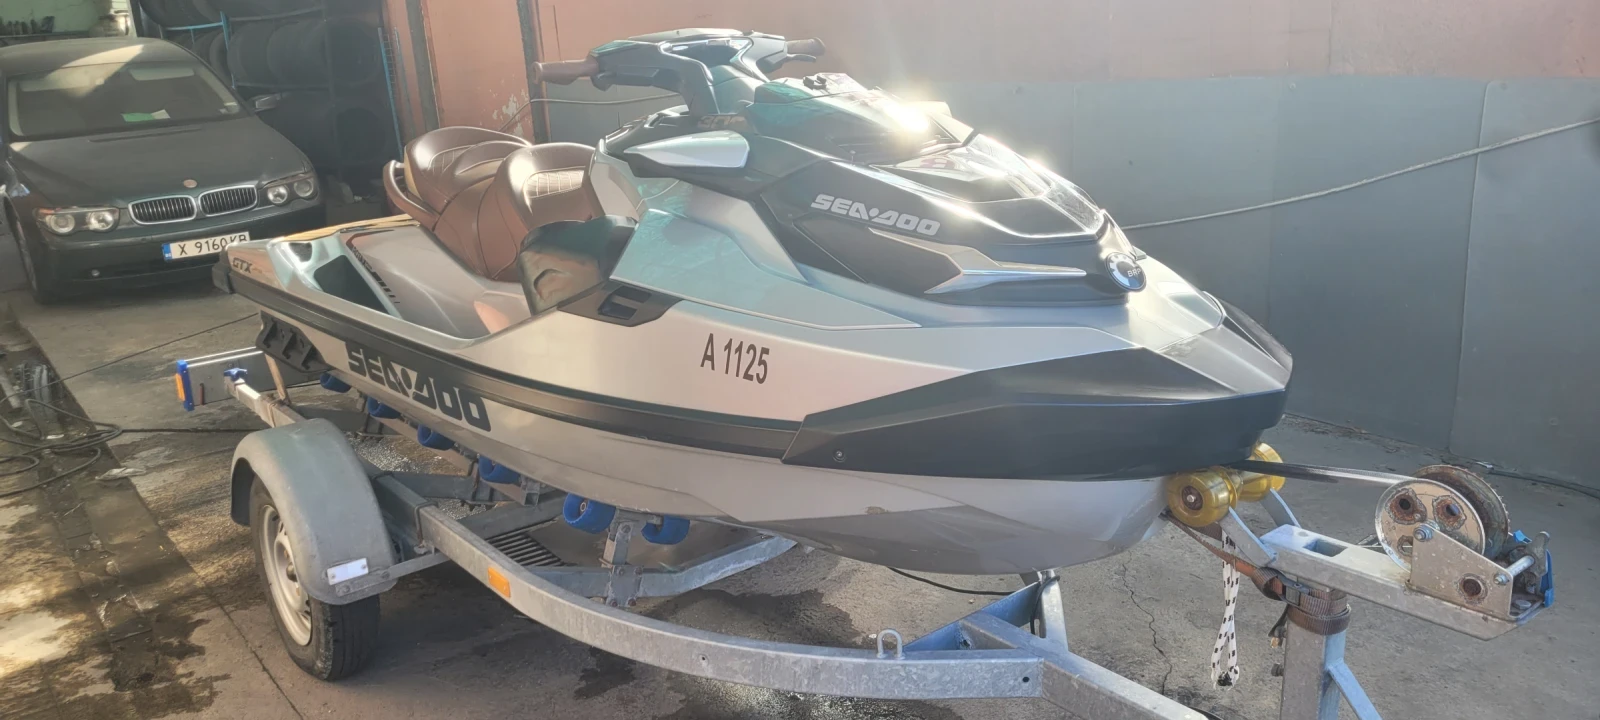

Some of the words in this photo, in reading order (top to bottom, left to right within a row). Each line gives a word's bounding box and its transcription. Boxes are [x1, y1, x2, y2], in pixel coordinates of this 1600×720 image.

[178, 243, 188, 256] X
[232, 256, 253, 274] GTX
[700, 332, 716, 371] A
[723, 337, 770, 385] 1125
